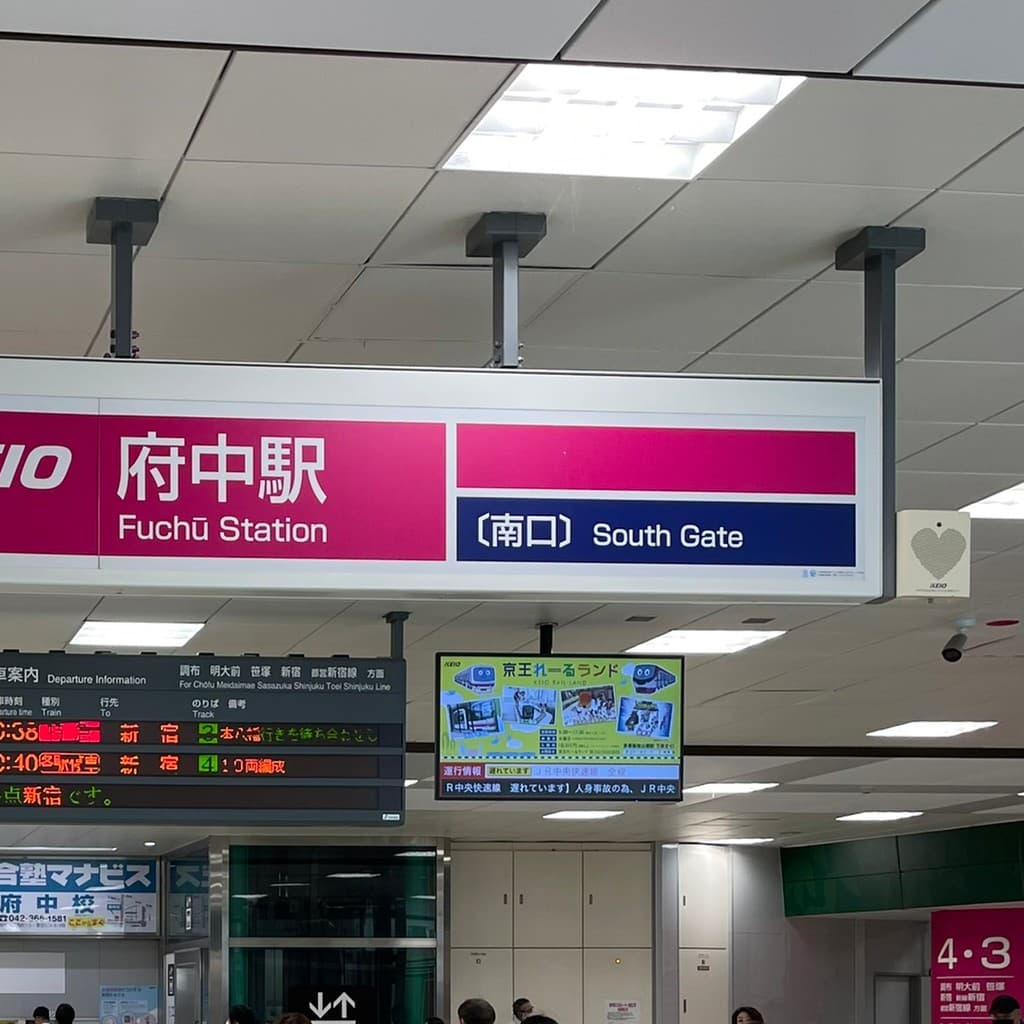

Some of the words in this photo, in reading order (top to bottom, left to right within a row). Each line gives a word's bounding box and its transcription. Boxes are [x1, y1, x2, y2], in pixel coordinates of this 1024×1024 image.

[116, 431, 328, 505] 府中駅
[118, 515, 209, 541] Fuchū
[219, 516, 328, 543] Station
[592, 522, 672, 548] South
[680, 524, 745, 549] Gate
[180, 665, 200, 677] 調布
[210, 665, 241, 677] 明大前
[251, 666, 271, 677] 笹塚
[281, 666, 301, 678] 新宿
[367, 669, 384, 679] 方面
[502, 662, 619, 678] 京王れーるランド
[47, 675, 93, 686] Departure
[96, 675, 146, 685] Information
[217, 681, 255, 689] Meidaimae
[257, 682, 292, 690] Sasazuka
[294, 682, 324, 691] Shinjuku
[327, 682, 342, 690] Toei
[344, 682, 373, 691] Shinjuku
[376, 683, 391, 691] Line
[41, 697, 60, 707] 種別
[100, 697, 119, 708] 行先
[192, 699, 219, 708] のりば
[41, 709, 61, 717] Train
[100, 709, 111, 717] To
[192, 710, 214, 718] Track
[443, 766, 481, 777] 運行情報
[0, 894, 95, 914] 府中校
